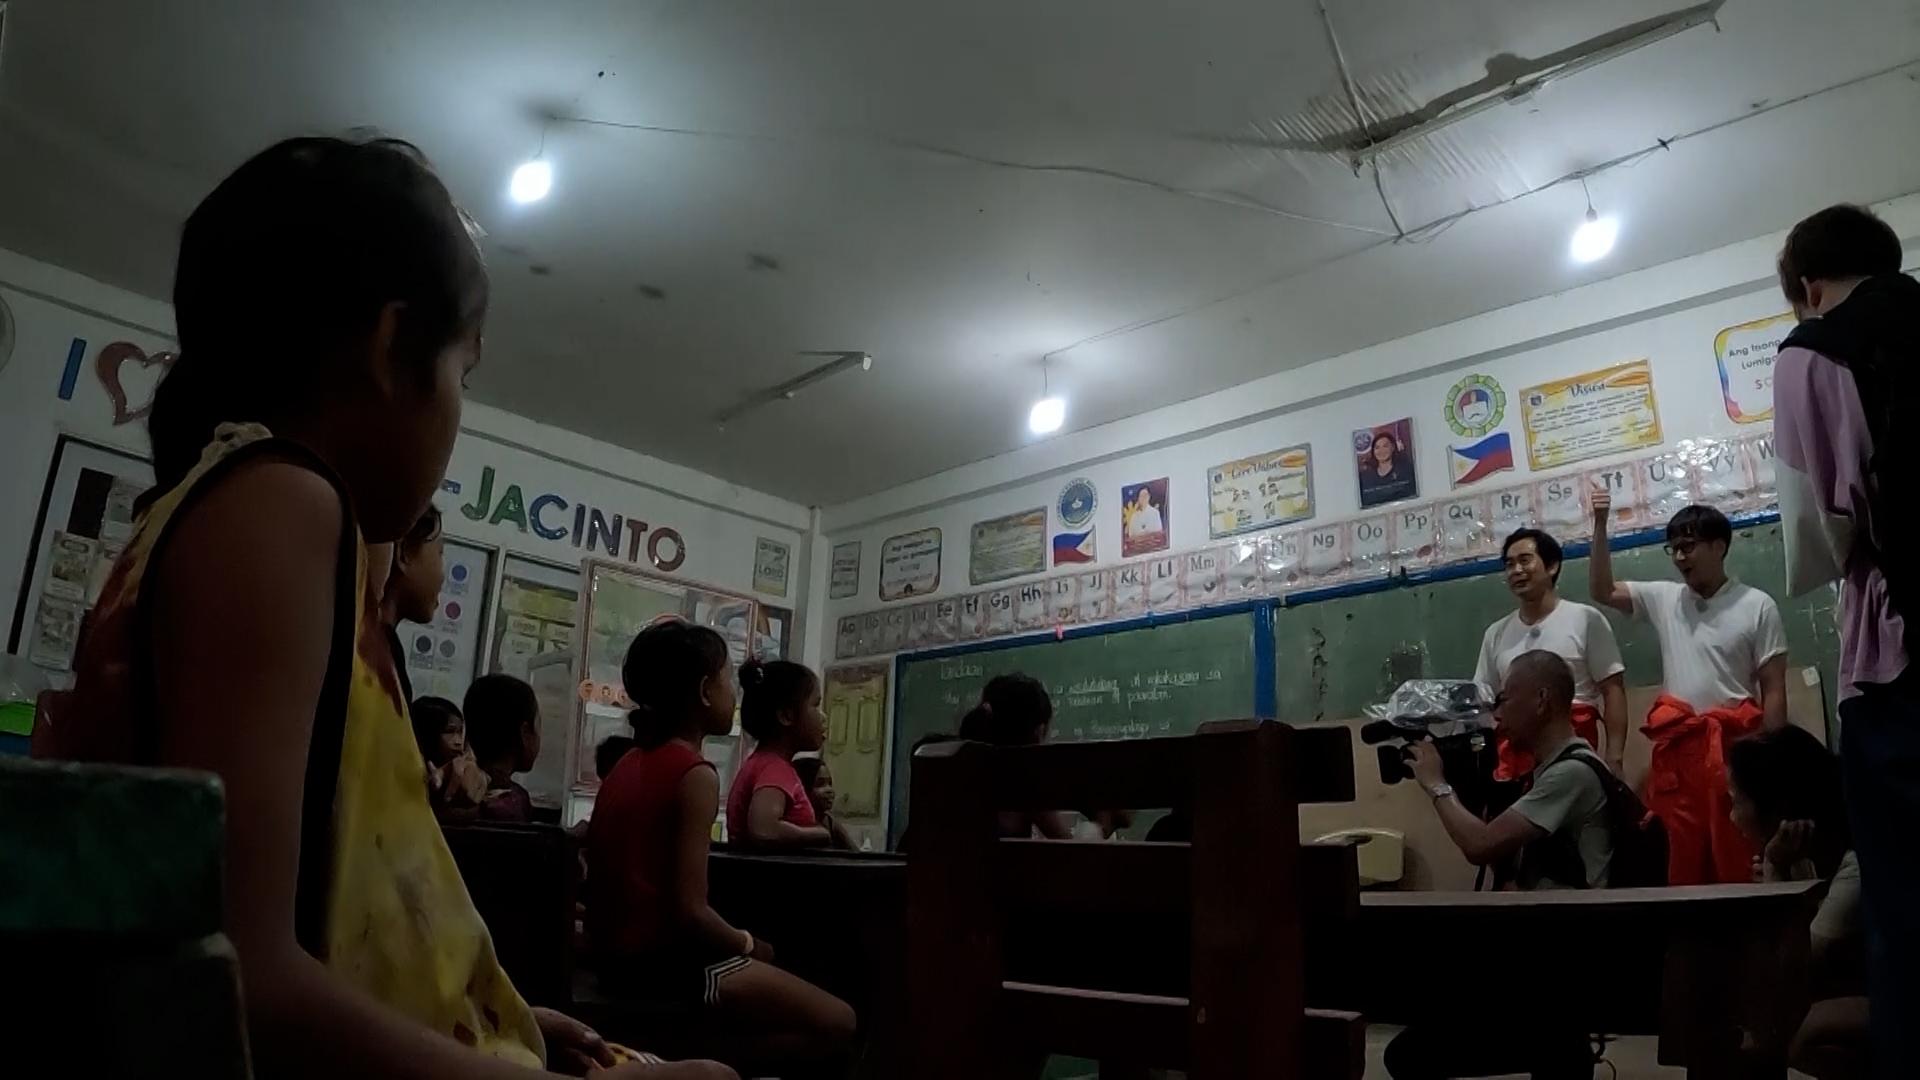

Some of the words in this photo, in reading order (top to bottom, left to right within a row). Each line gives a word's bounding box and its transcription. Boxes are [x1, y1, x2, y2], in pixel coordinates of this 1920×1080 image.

[1729, 347, 1749, 357] Ang
[937, 603, 952, 617] Ee
[966, 597, 979, 613] Ff
[990, 593, 1009, 609] Gg
[1021, 585, 1041, 602] Hh
[1055, 580, 1068, 594] Ii
[1089, 573, 1102, 590] Jj
[1120, 568, 1138, 584] Kk
[1157, 560, 1172, 578] Ll
[1190, 555, 1215, 572] Mm
[1313, 533, 1335, 548] Ng
[1357, 523, 1382, 541] Oo
[1403, 512, 1427, 530] Pp
[1448, 504, 1473, 520] Qq
[1501, 493, 1521, 510] Rr
[1547, 484, 1573, 502] Ss
[1601, 471, 1623, 490] Tt
